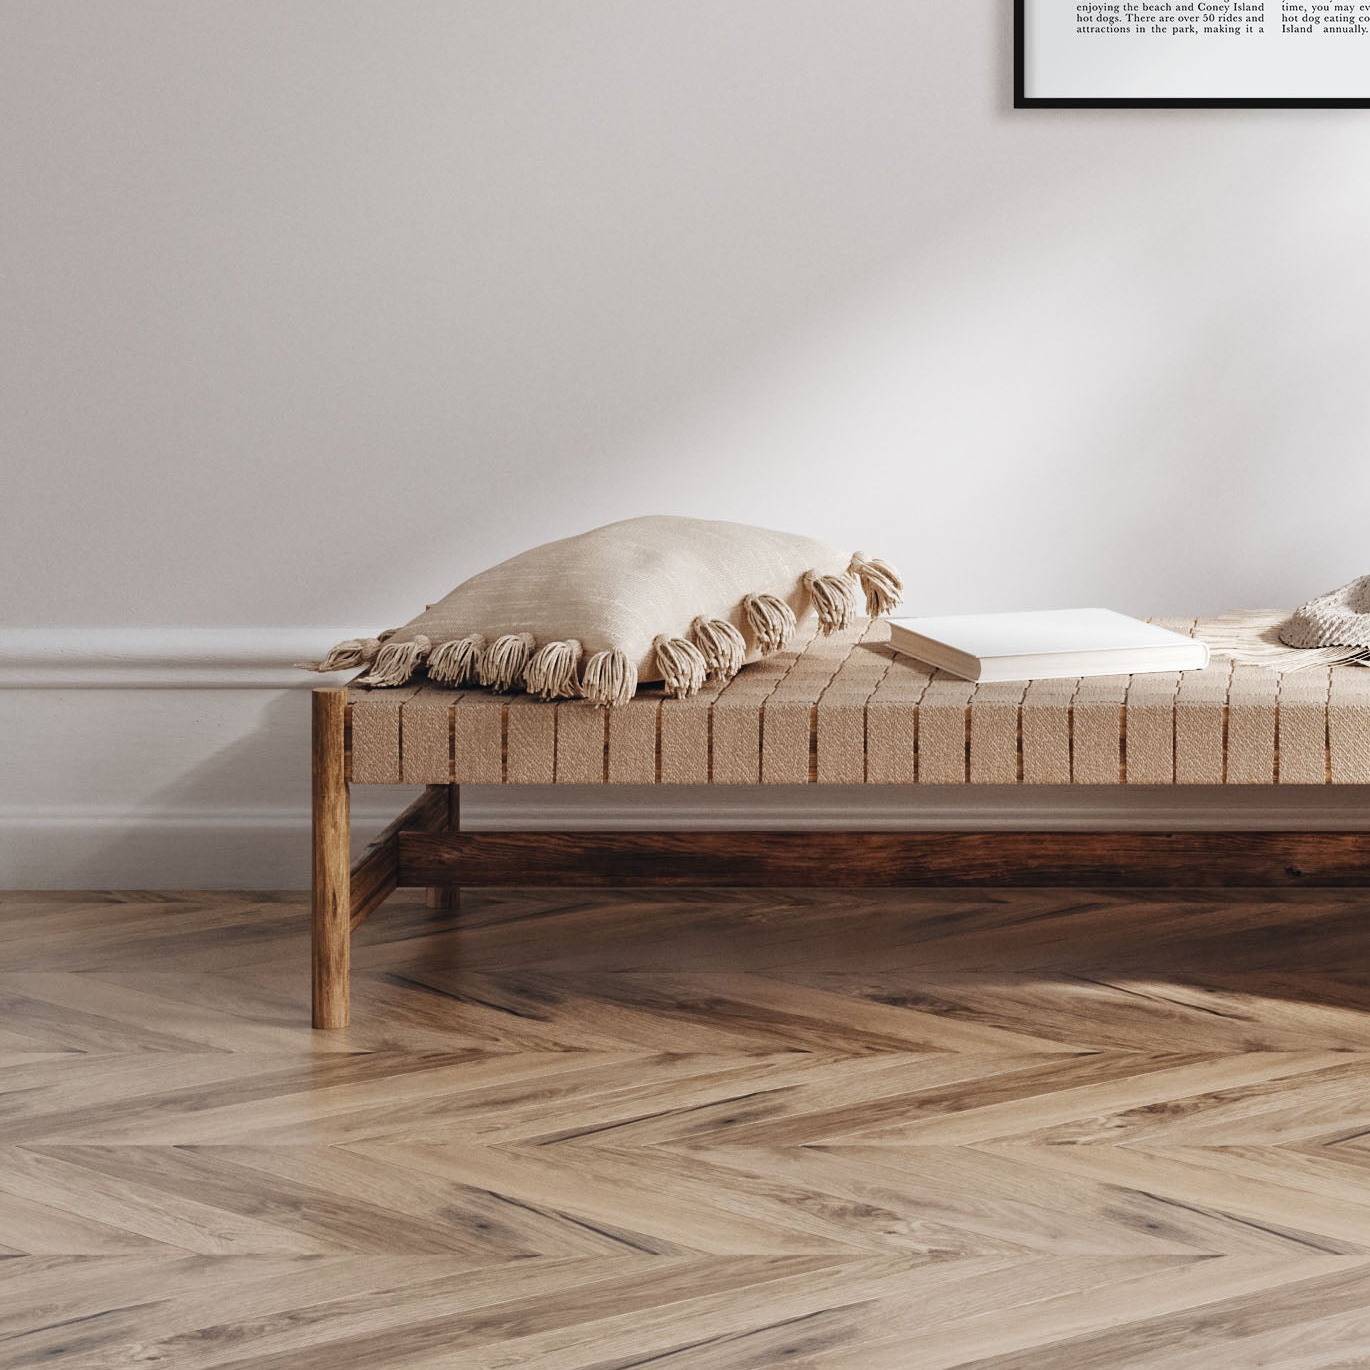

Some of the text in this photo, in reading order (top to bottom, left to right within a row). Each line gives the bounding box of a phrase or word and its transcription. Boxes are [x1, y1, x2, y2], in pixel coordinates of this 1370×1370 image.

[1281, 3, 1307, 14] time,
[1311, 5, 1330, 14] you
[1334, 5, 1355, 14] may
